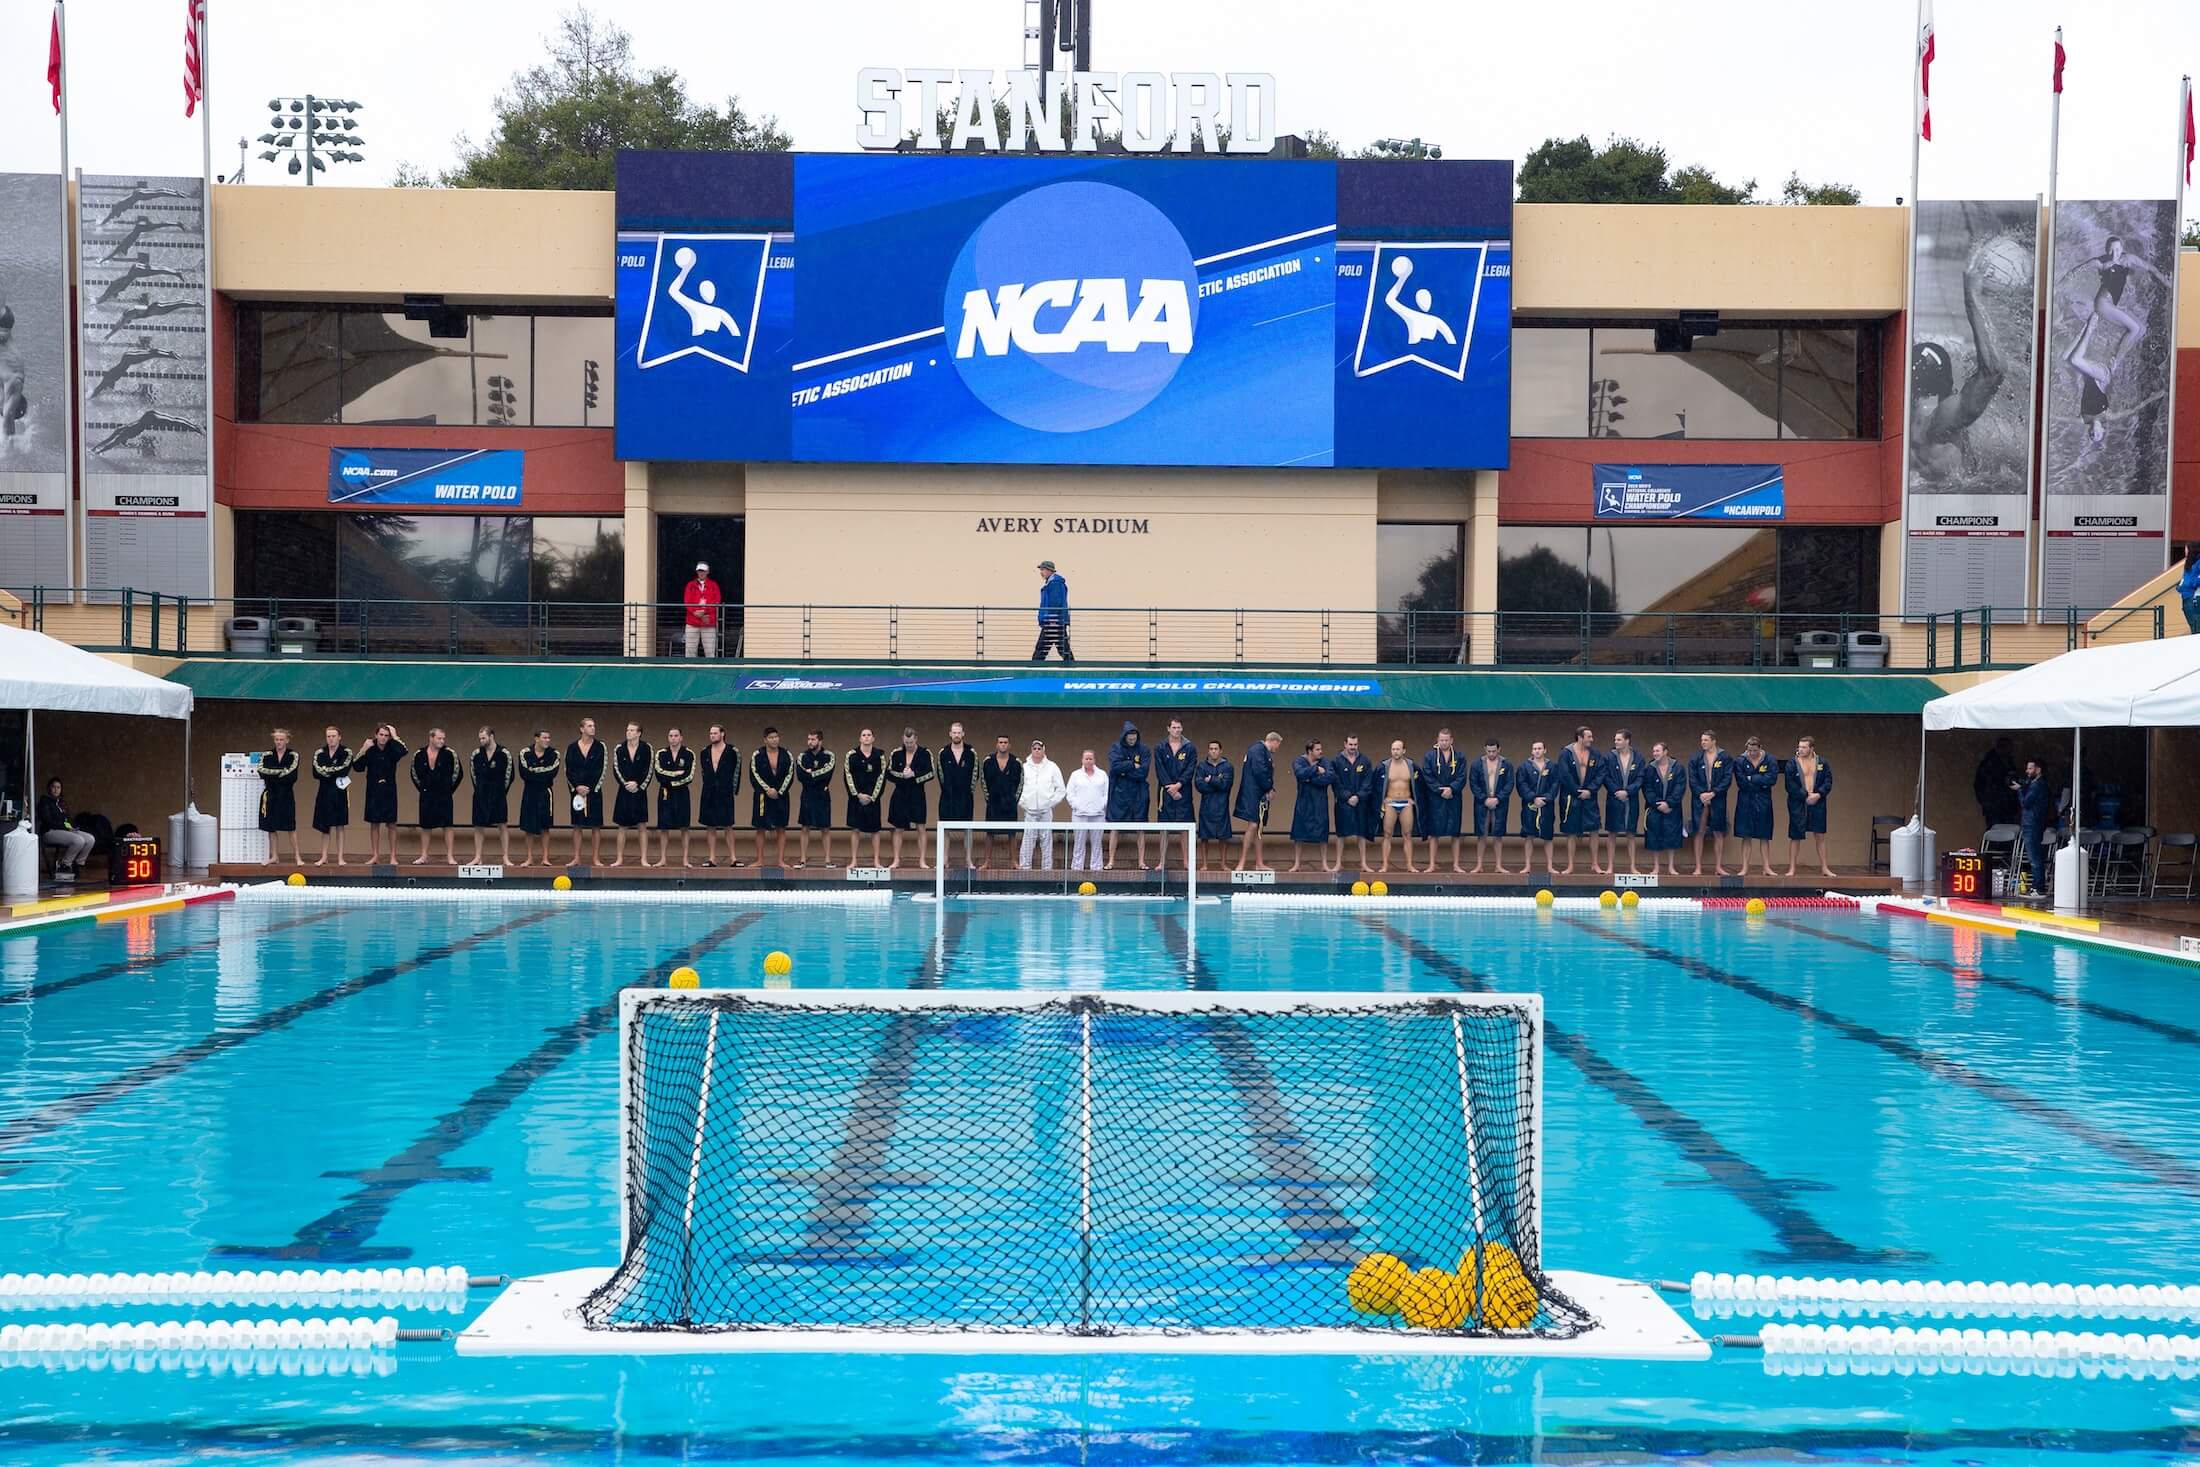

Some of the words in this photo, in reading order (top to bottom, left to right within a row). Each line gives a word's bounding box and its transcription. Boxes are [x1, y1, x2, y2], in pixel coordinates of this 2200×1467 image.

[856, 67, 1276, 153] STANFORD
[621, 256, 646, 268] POLO
[1226, 258, 1301, 291] ASSOCIATION
[1338, 265, 1363, 277] POLO
[955, 278, 1193, 359] NCAA
[822, 361, 913, 400] ASSOCIATION
[343, 467, 398, 476] NCAA.com
[435, 485, 478, 499] WATER
[482, 485, 517, 500] POLO
[1626, 493, 1656, 503] WATER
[1657, 493, 1681, 503] POLO
[119, 497, 175, 506] CHAMPIONS
[1724, 505, 1781, 516] #NCAAWPOLO
[976, 518, 1042, 533] AVERY
[1054, 518, 1149, 534] STADIUM
[1940, 516, 1994, 526] CHAMPIONS
[2078, 517, 2133, 526] CHAMPIONS
[1064, 682, 1136, 690] WATER
[1203, 683, 1371, 692] CHAMPIONSHIP
[130, 844, 157, 856] 7:37
[128, 860, 150, 877] 30
[1955, 858, 1981, 871] 7:37
[1953, 874, 1975, 892] 30
